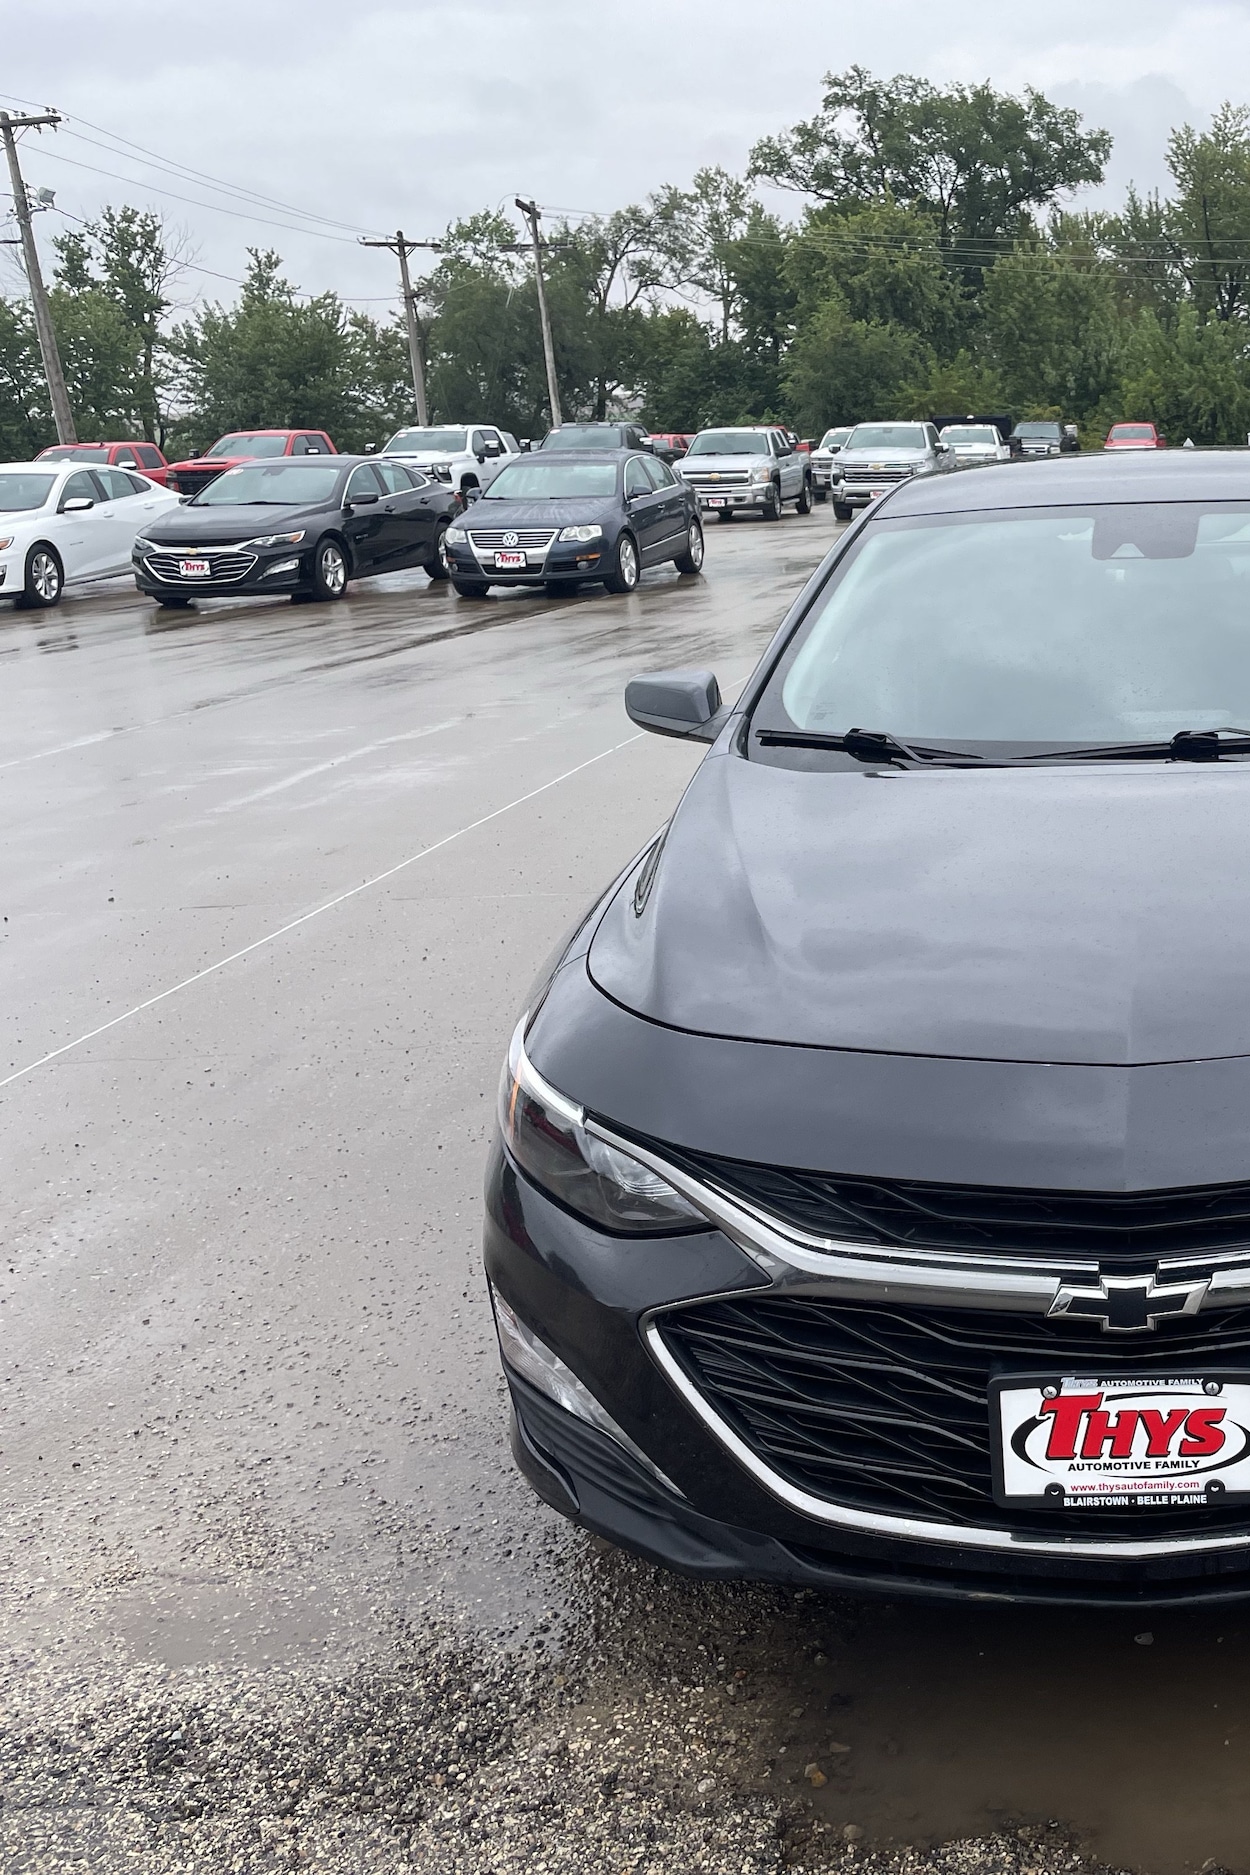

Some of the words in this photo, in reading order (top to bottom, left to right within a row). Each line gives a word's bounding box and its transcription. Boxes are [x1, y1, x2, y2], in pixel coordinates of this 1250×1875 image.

[1100, 1379, 1165, 1387] AUTOMOTIVE
[1168, 1378, 1204, 1386] FAMILY
[1039, 1392, 1227, 1460] THYS
[1068, 1461, 1151, 1471] AUTOMOTIVE
[1155, 1460, 1200, 1469] FAMILY
[1070, 1480, 1200, 1493] www.thysautofamily.com
[1063, 1496, 1129, 1507] BLAIRSTOWN
[1137, 1495, 1169, 1505] BELLE
[1171, 1494, 1207, 1505] PLAINE
